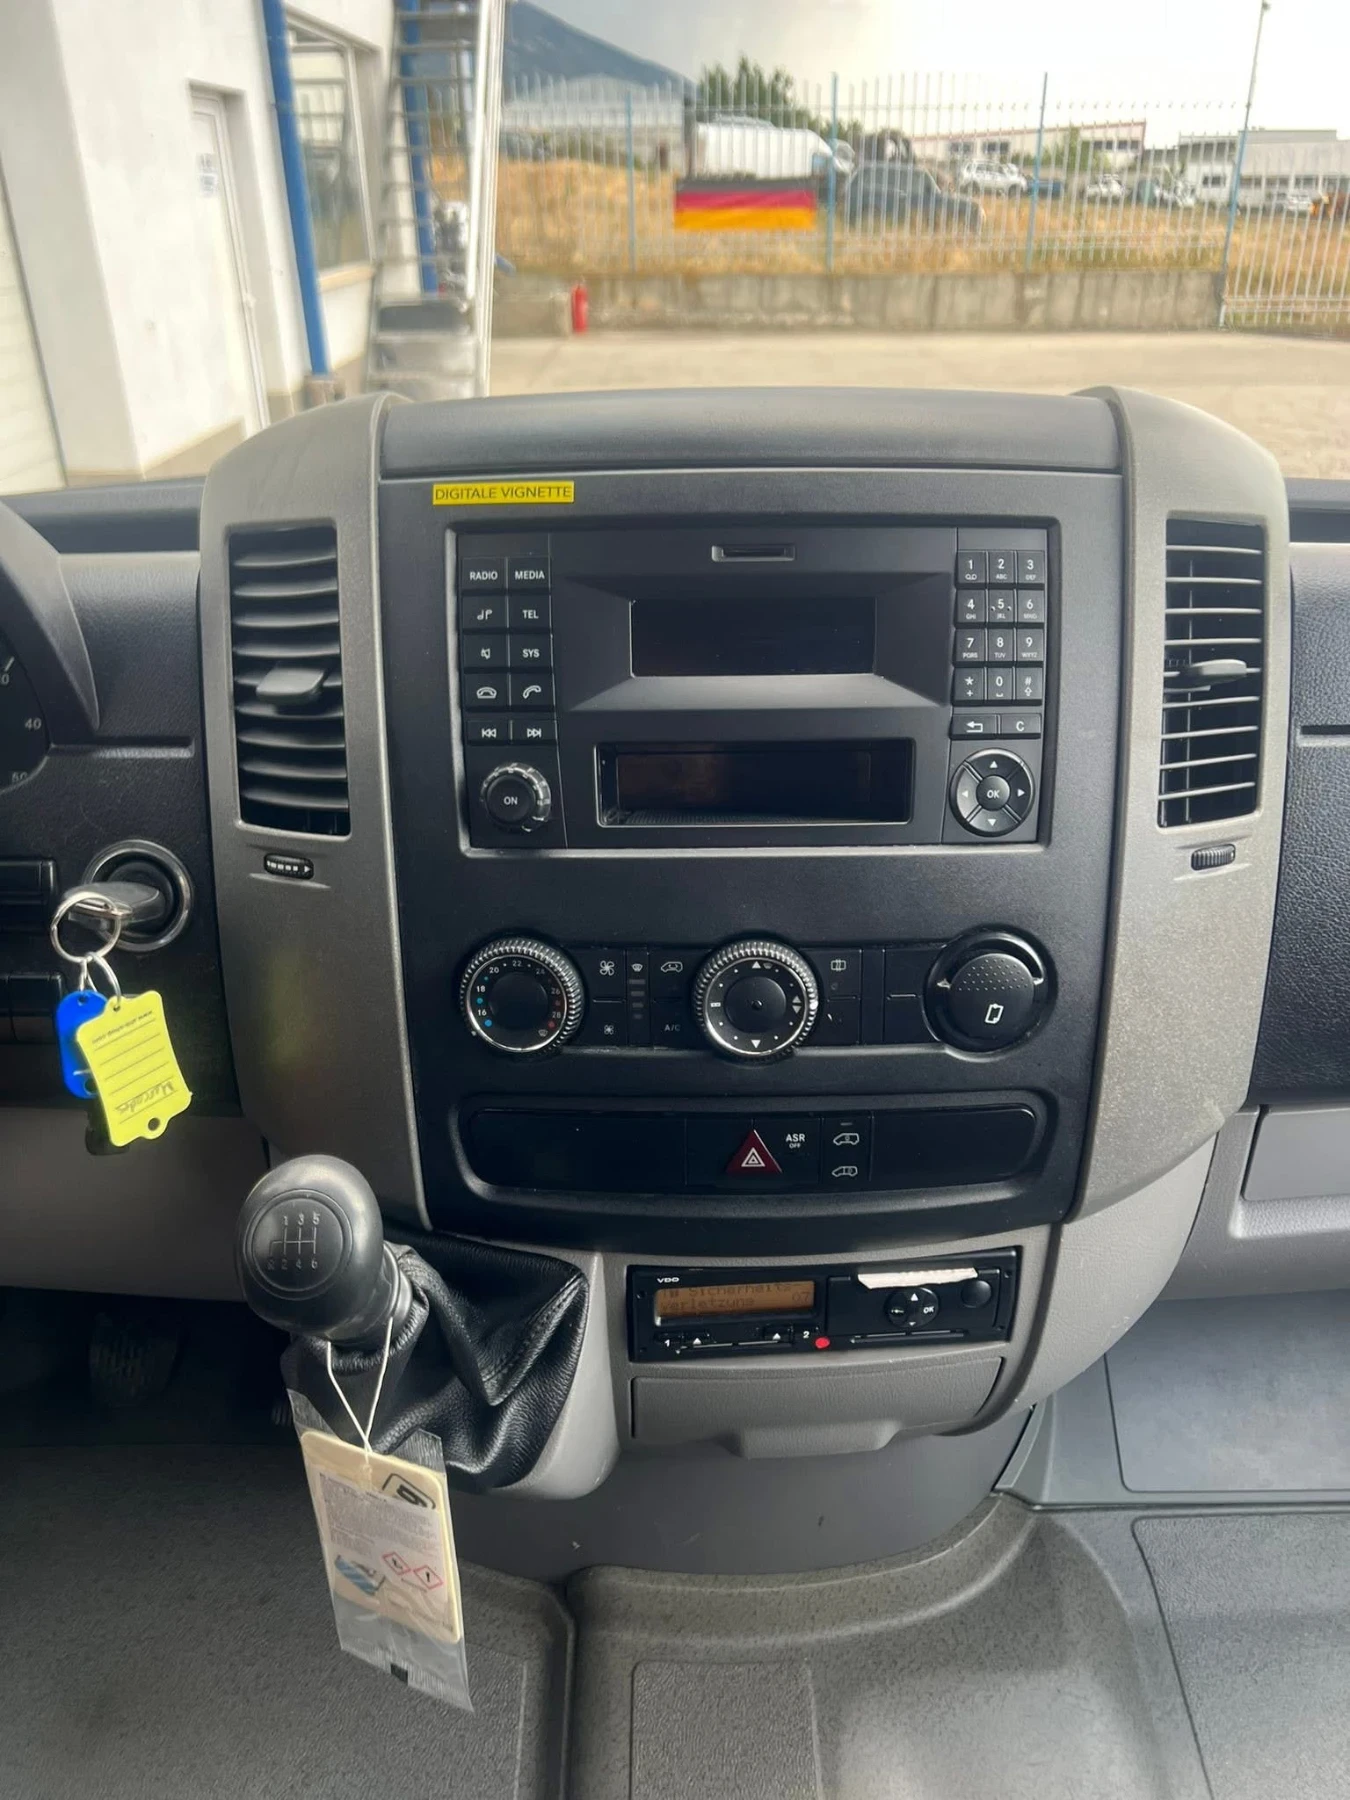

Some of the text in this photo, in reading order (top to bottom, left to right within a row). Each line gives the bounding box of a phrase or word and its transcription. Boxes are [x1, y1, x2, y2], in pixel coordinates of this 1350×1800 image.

[435, 486, 572, 500] DIGITALE VIGNETTE
[968, 559, 974, 570] 1
[997, 558, 1005, 570] 2
[1026, 559, 1034, 570] 3
[469, 571, 498, 581] RADIO
[514, 570, 545, 580] MEDIA
[967, 598, 975, 610] 4
[997, 598, 1005, 610] 5
[1026, 599, 1034, 610] 6
[522, 609, 539, 619] TEL
[966, 637, 975, 648] 7
[996, 637, 1004, 648] 8
[1025, 636, 1033, 648] 9
[522, 648, 540, 658] SYS
[995, 676, 1003, 687] 0
[25, 717, 42, 730] 40
[1015, 720, 1025, 732] C
[986, 789, 1000, 799] OK
[503, 796, 518, 806] ON
[489, 966, 500, 974] 20
[476, 985, 486, 993] 18
[477, 1008, 487, 1017] 16
[664, 1023, 681, 1032] A/C
[785, 1133, 806, 1142] ASR
[297, 1213, 305, 1226] 3
[312, 1211, 321, 1226] 5
[656, 1276, 680, 1284] VDO
[923, 1306, 935, 1314] OK
[802, 1330, 810, 1339] 2
[664, 1339, 671, 1348] 1
